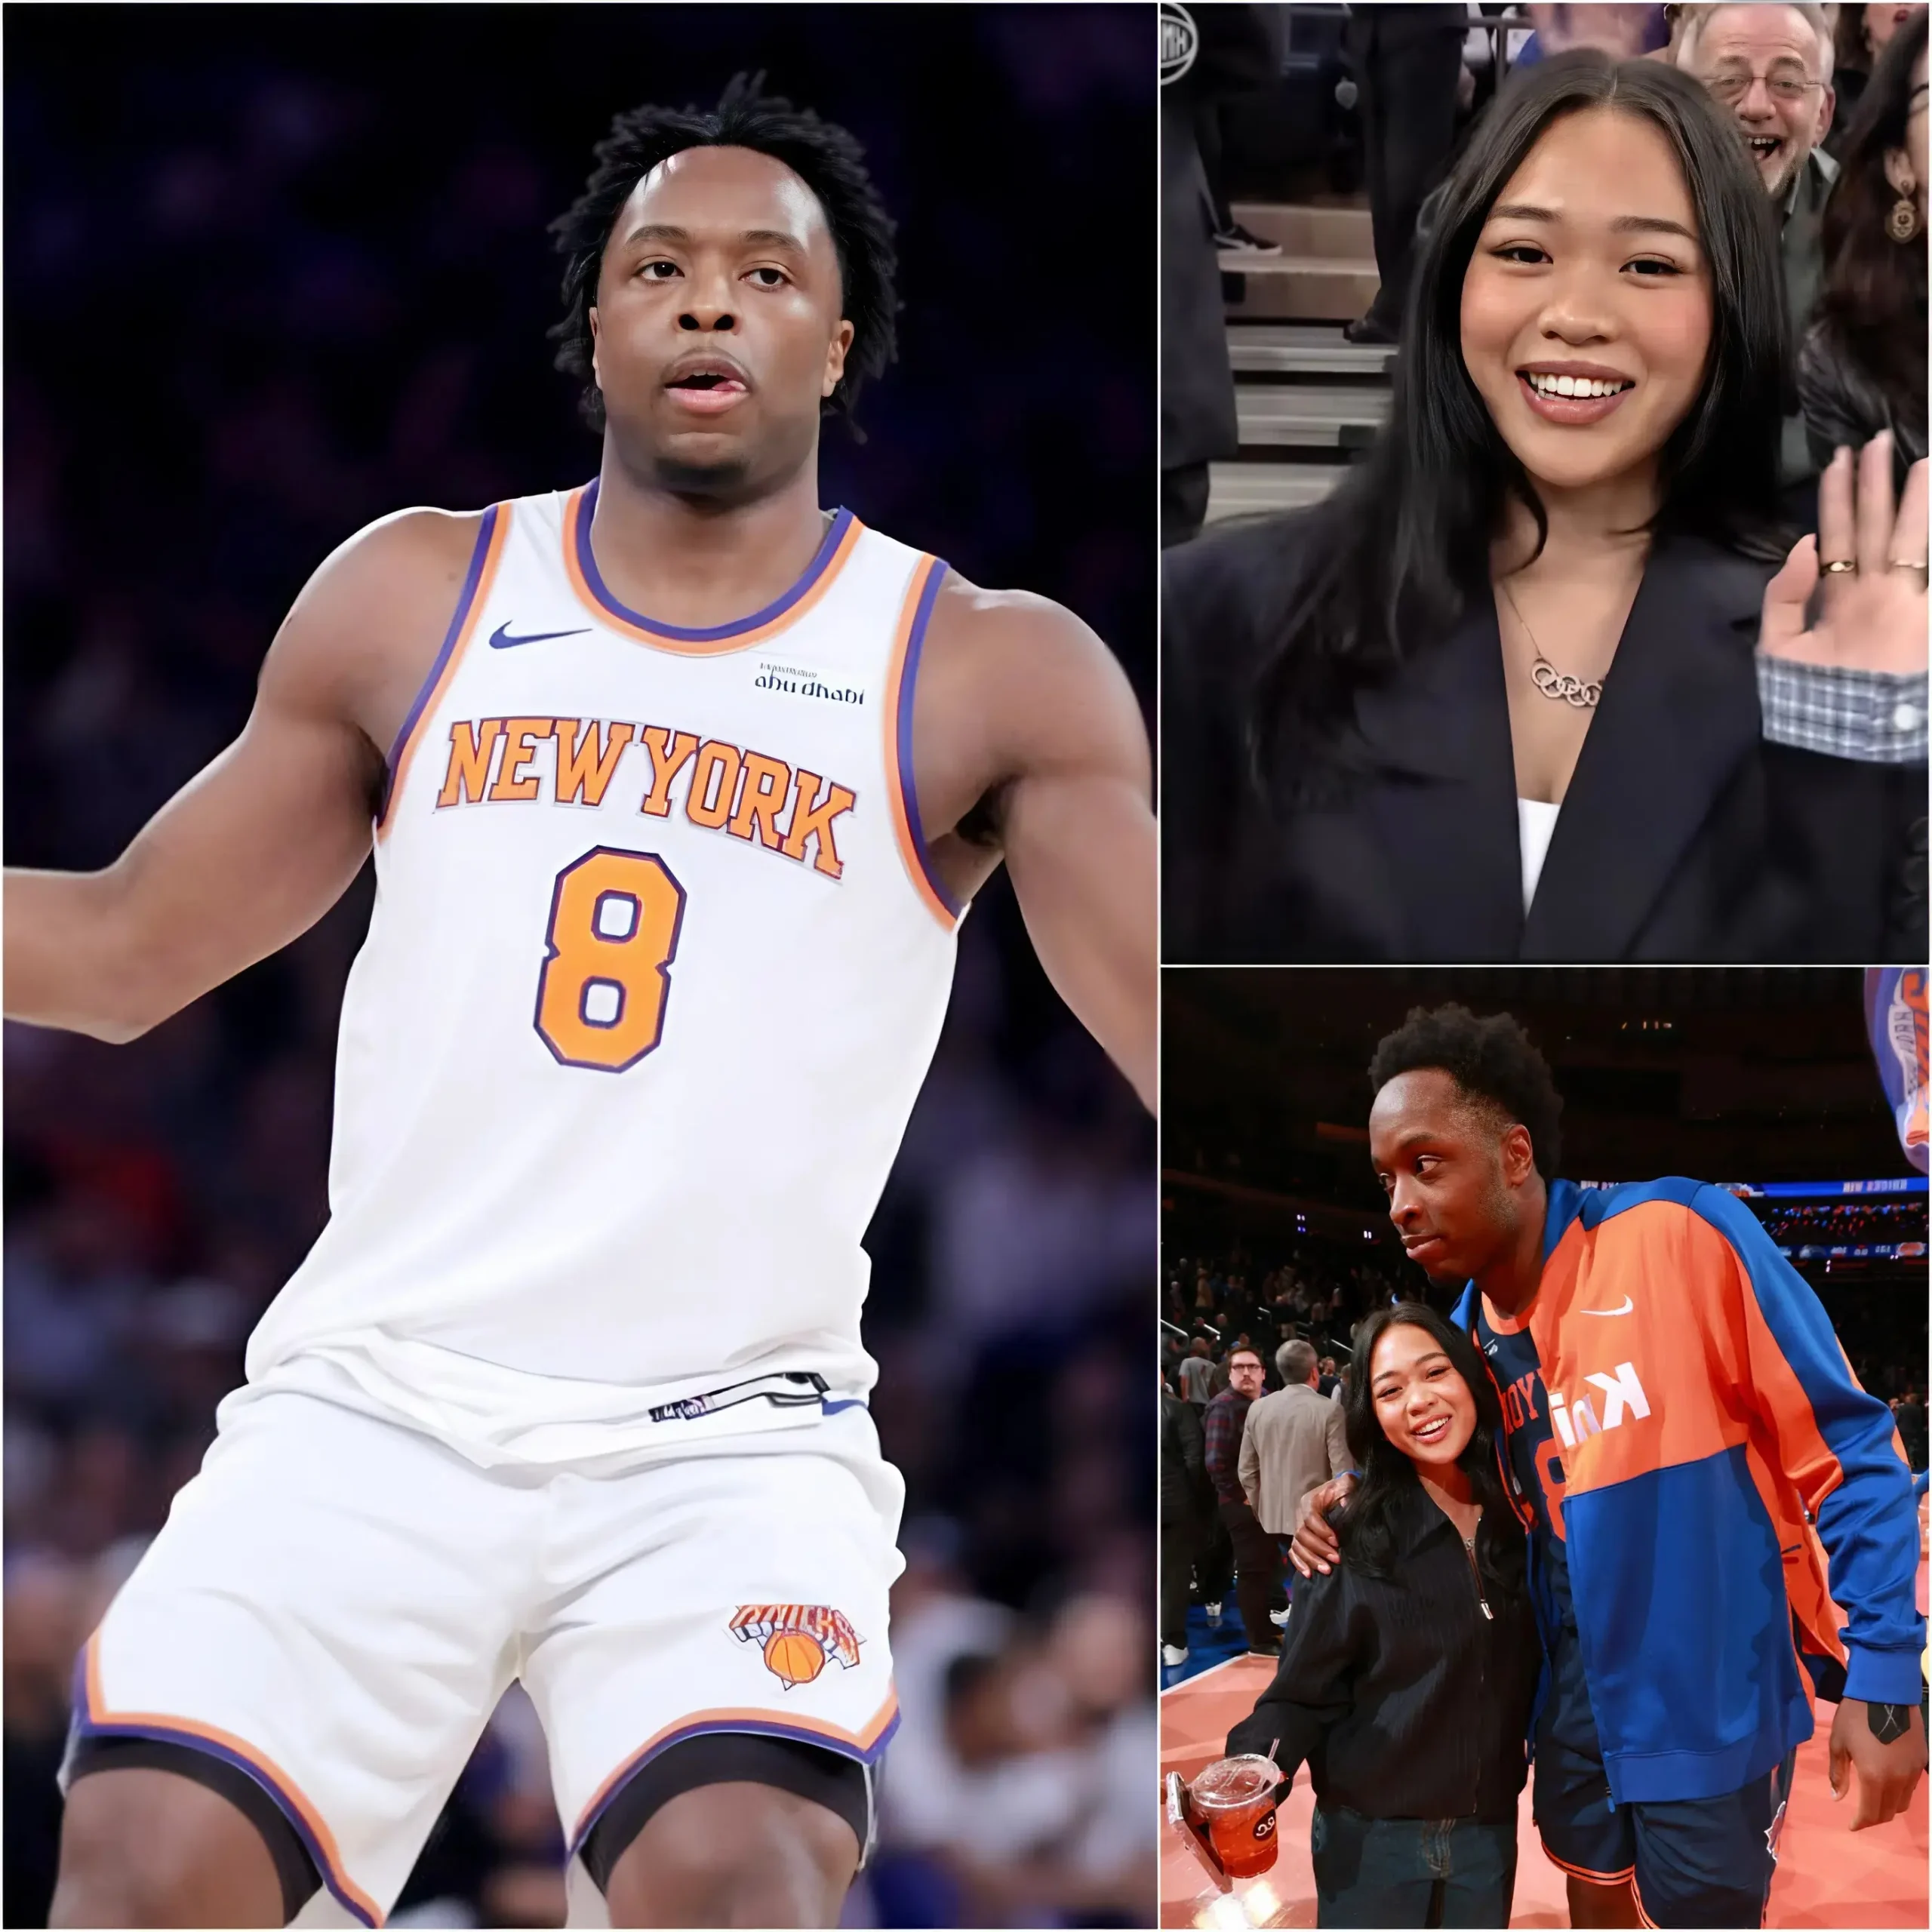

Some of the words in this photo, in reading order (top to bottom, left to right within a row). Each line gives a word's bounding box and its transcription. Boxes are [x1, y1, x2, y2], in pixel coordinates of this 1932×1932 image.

[755, 666, 796, 693] abu
[801, 681, 865, 705] dhabi
[435, 716, 635, 810] NEW
[638, 722, 859, 881] YORK
[533, 845, 687, 1073] 8
